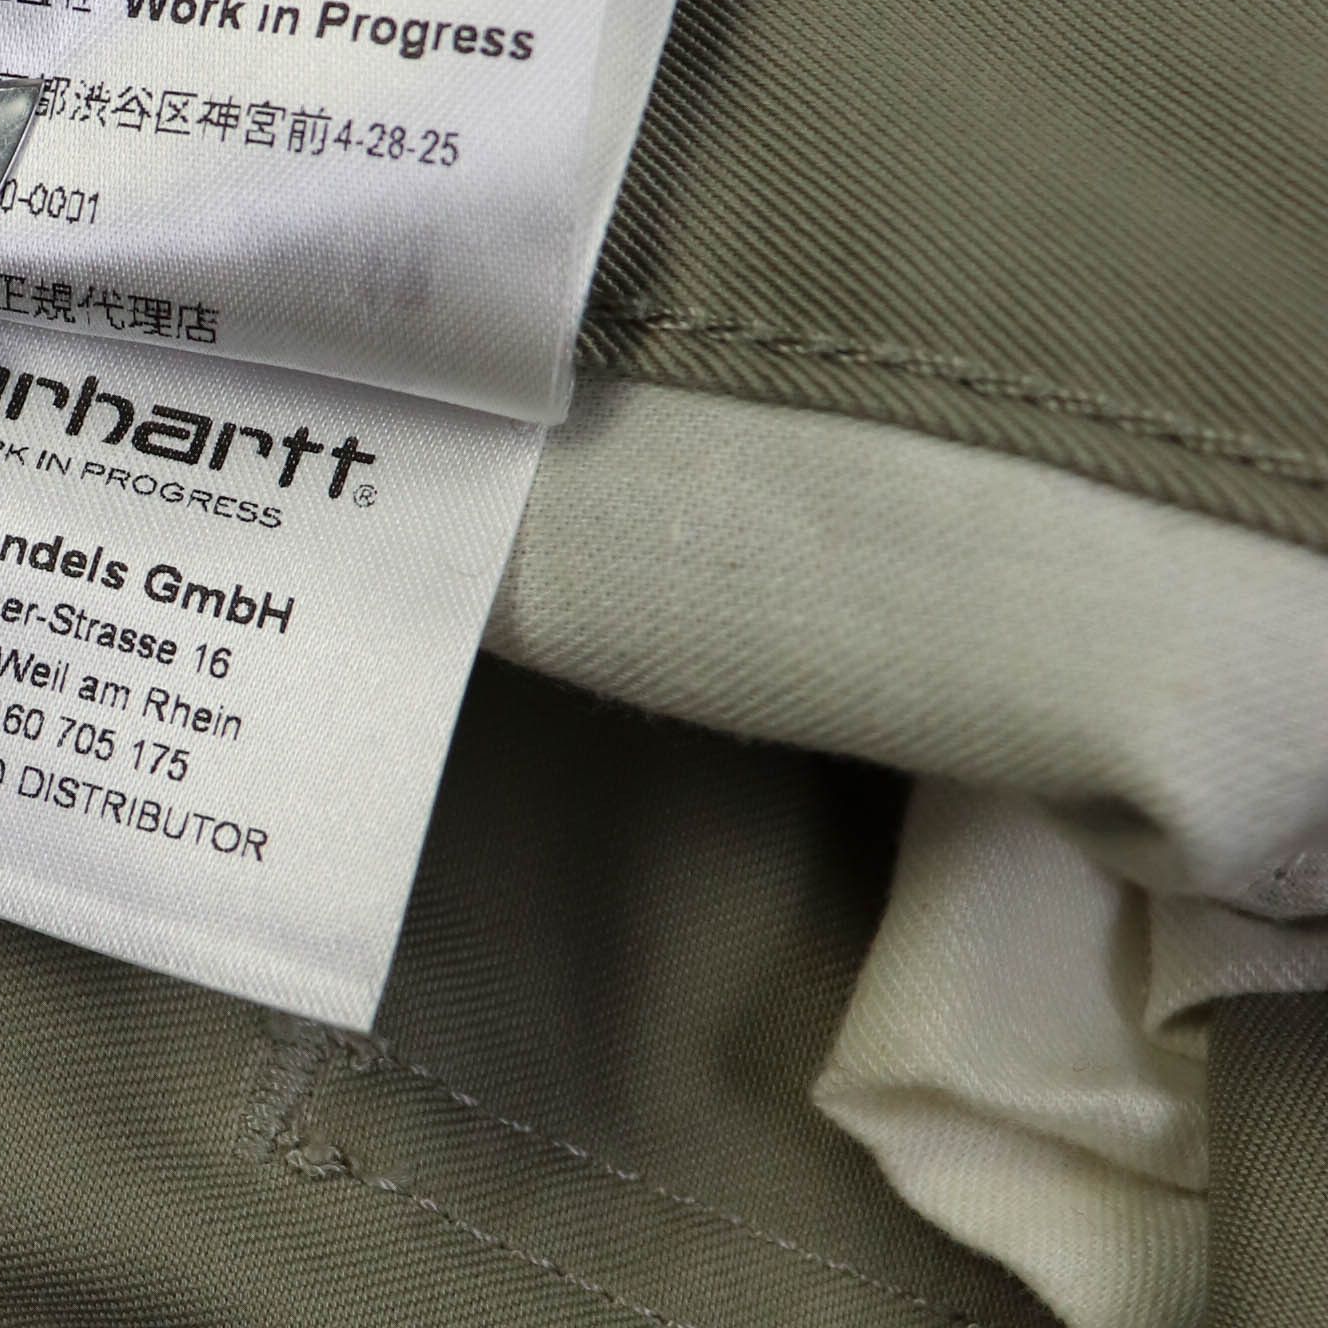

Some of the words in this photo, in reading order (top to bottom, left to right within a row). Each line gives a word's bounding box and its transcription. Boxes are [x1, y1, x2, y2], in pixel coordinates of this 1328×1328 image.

[316, 0, 535, 60] Progress
[0, 178, 99, 224] 0-0001
[35, 449, 73, 476] IN
[81, 460, 283, 529] PROGRESS
[144, 563, 295, 634] GmbH
[195, 643, 232, 679] 16
[78, 675, 130, 711] am
[143, 687, 242, 741] Rhein
[57, 715, 115, 761] 705
[133, 739, 189, 782] 175
[18, 765, 268, 862] DISTRIBUTOR
